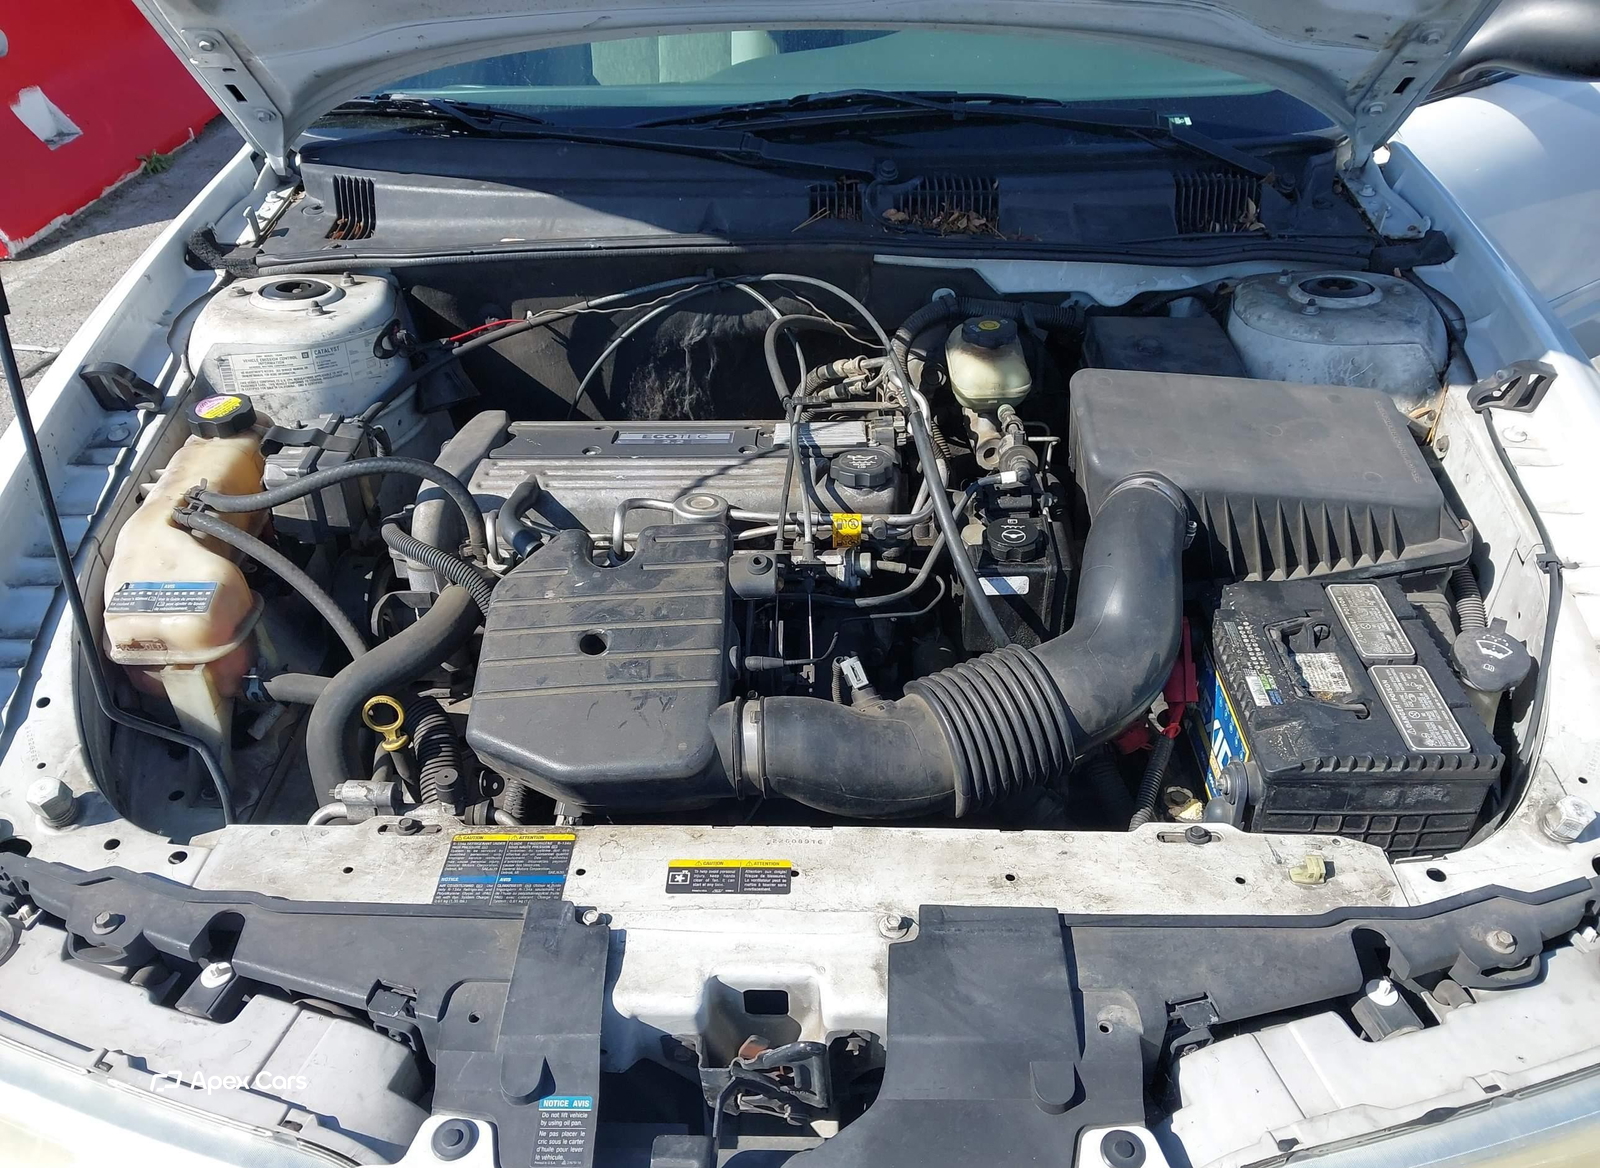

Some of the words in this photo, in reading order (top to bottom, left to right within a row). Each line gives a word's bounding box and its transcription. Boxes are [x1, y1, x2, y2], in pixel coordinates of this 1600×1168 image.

[314, 346, 340, 355] CATALYST
[1382, 680, 1397, 701] POISON
[1395, 704, 1413, 729] DANGER
